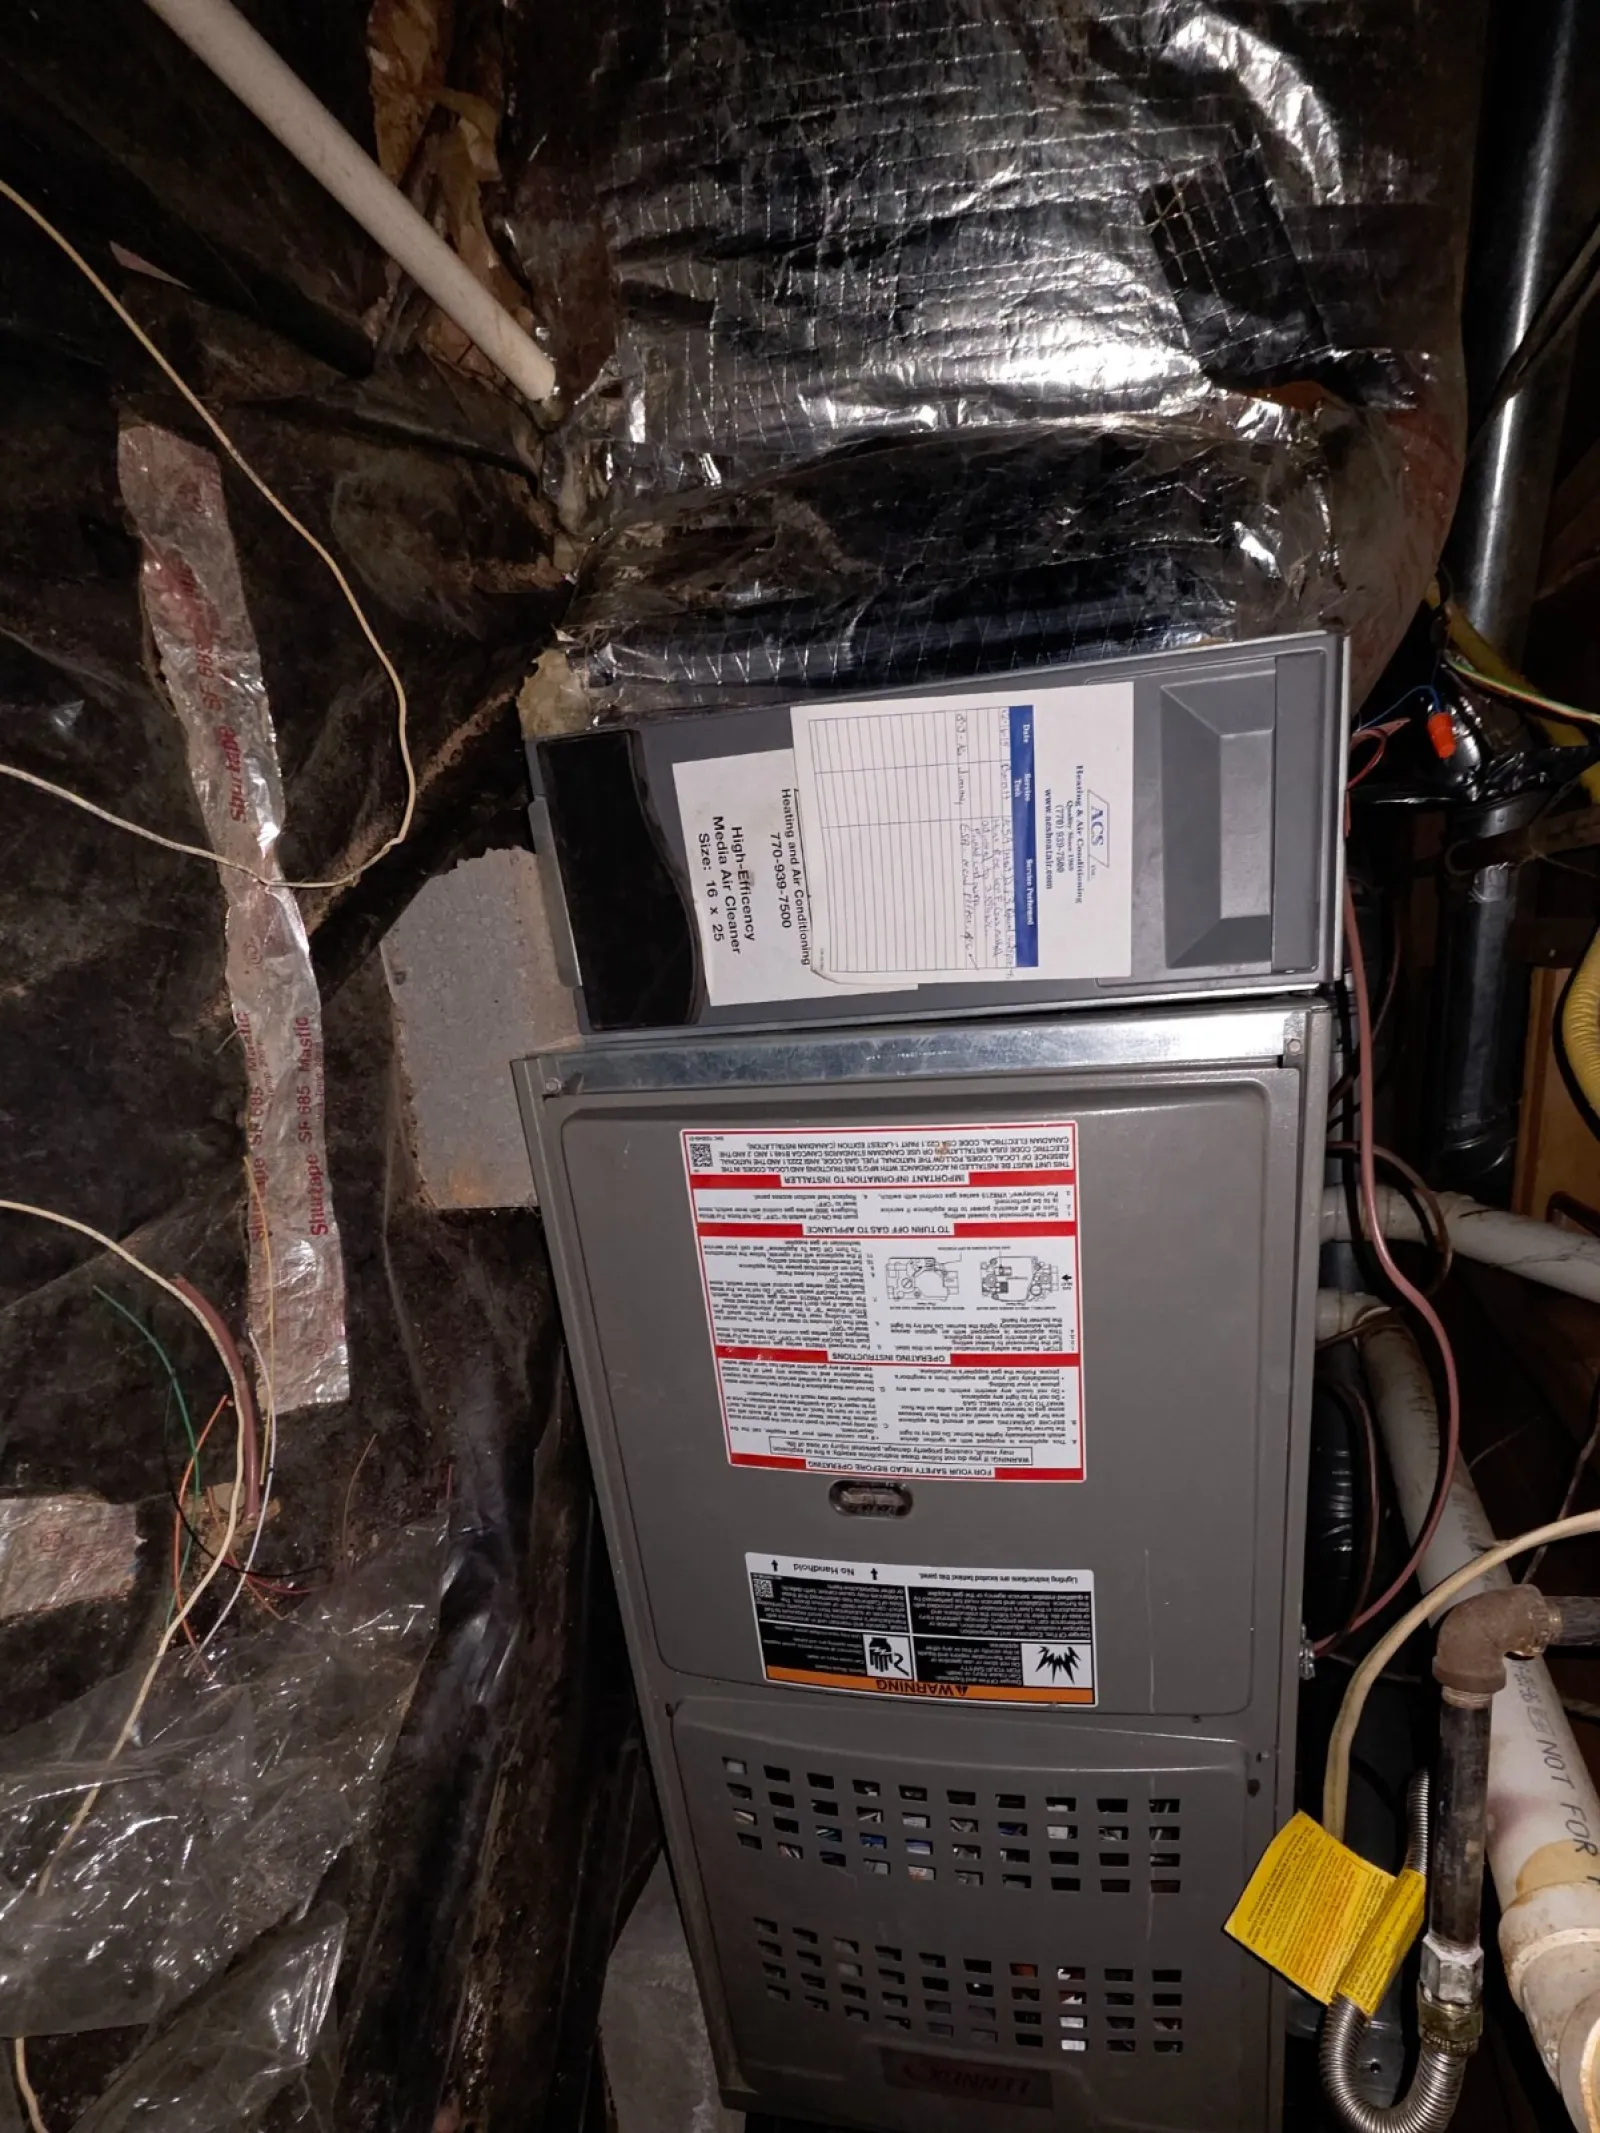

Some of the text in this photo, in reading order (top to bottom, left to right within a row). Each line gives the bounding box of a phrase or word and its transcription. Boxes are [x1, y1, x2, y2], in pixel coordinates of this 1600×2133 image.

[1022, 724, 1030, 744] Date
[1014, 779, 1022, 798] Tech
[1075, 765, 1084, 806] Heating
[1066, 800, 1074, 828] Quality
[1076, 820, 1084, 834] Air
[1091, 806, 1104, 846] ACS
[1054, 804, 1065, 874] (770) 939-7500
[698, 833, 724, 942] Size: 16 x 25
[712, 816, 742, 954] Media Air Cleaner
[770, 832, 792, 928] 770-939-7500
[782, 788, 811, 966] Heating and Air Conditioning
[1076, 838, 1084, 904] Conditioning
[1026, 888, 1034, 926] Performed
[294, 1015, 329, 1236] Shurtape SF 685 Mastic
[784, 1173, 964, 1184] IMPORTANT INFORMATION TO INSTALLER
[807, 1225, 949, 1234] TO TURN OFF GAS TO APPLIANCE
[832, 1352, 945, 1362] OPERATING INSTRUCTIONS
[793, 1563, 855, 1576] No Handhold
[876, 1678, 954, 1697] WARNING
[1537, 1738, 1599, 1857] NOT FOR
